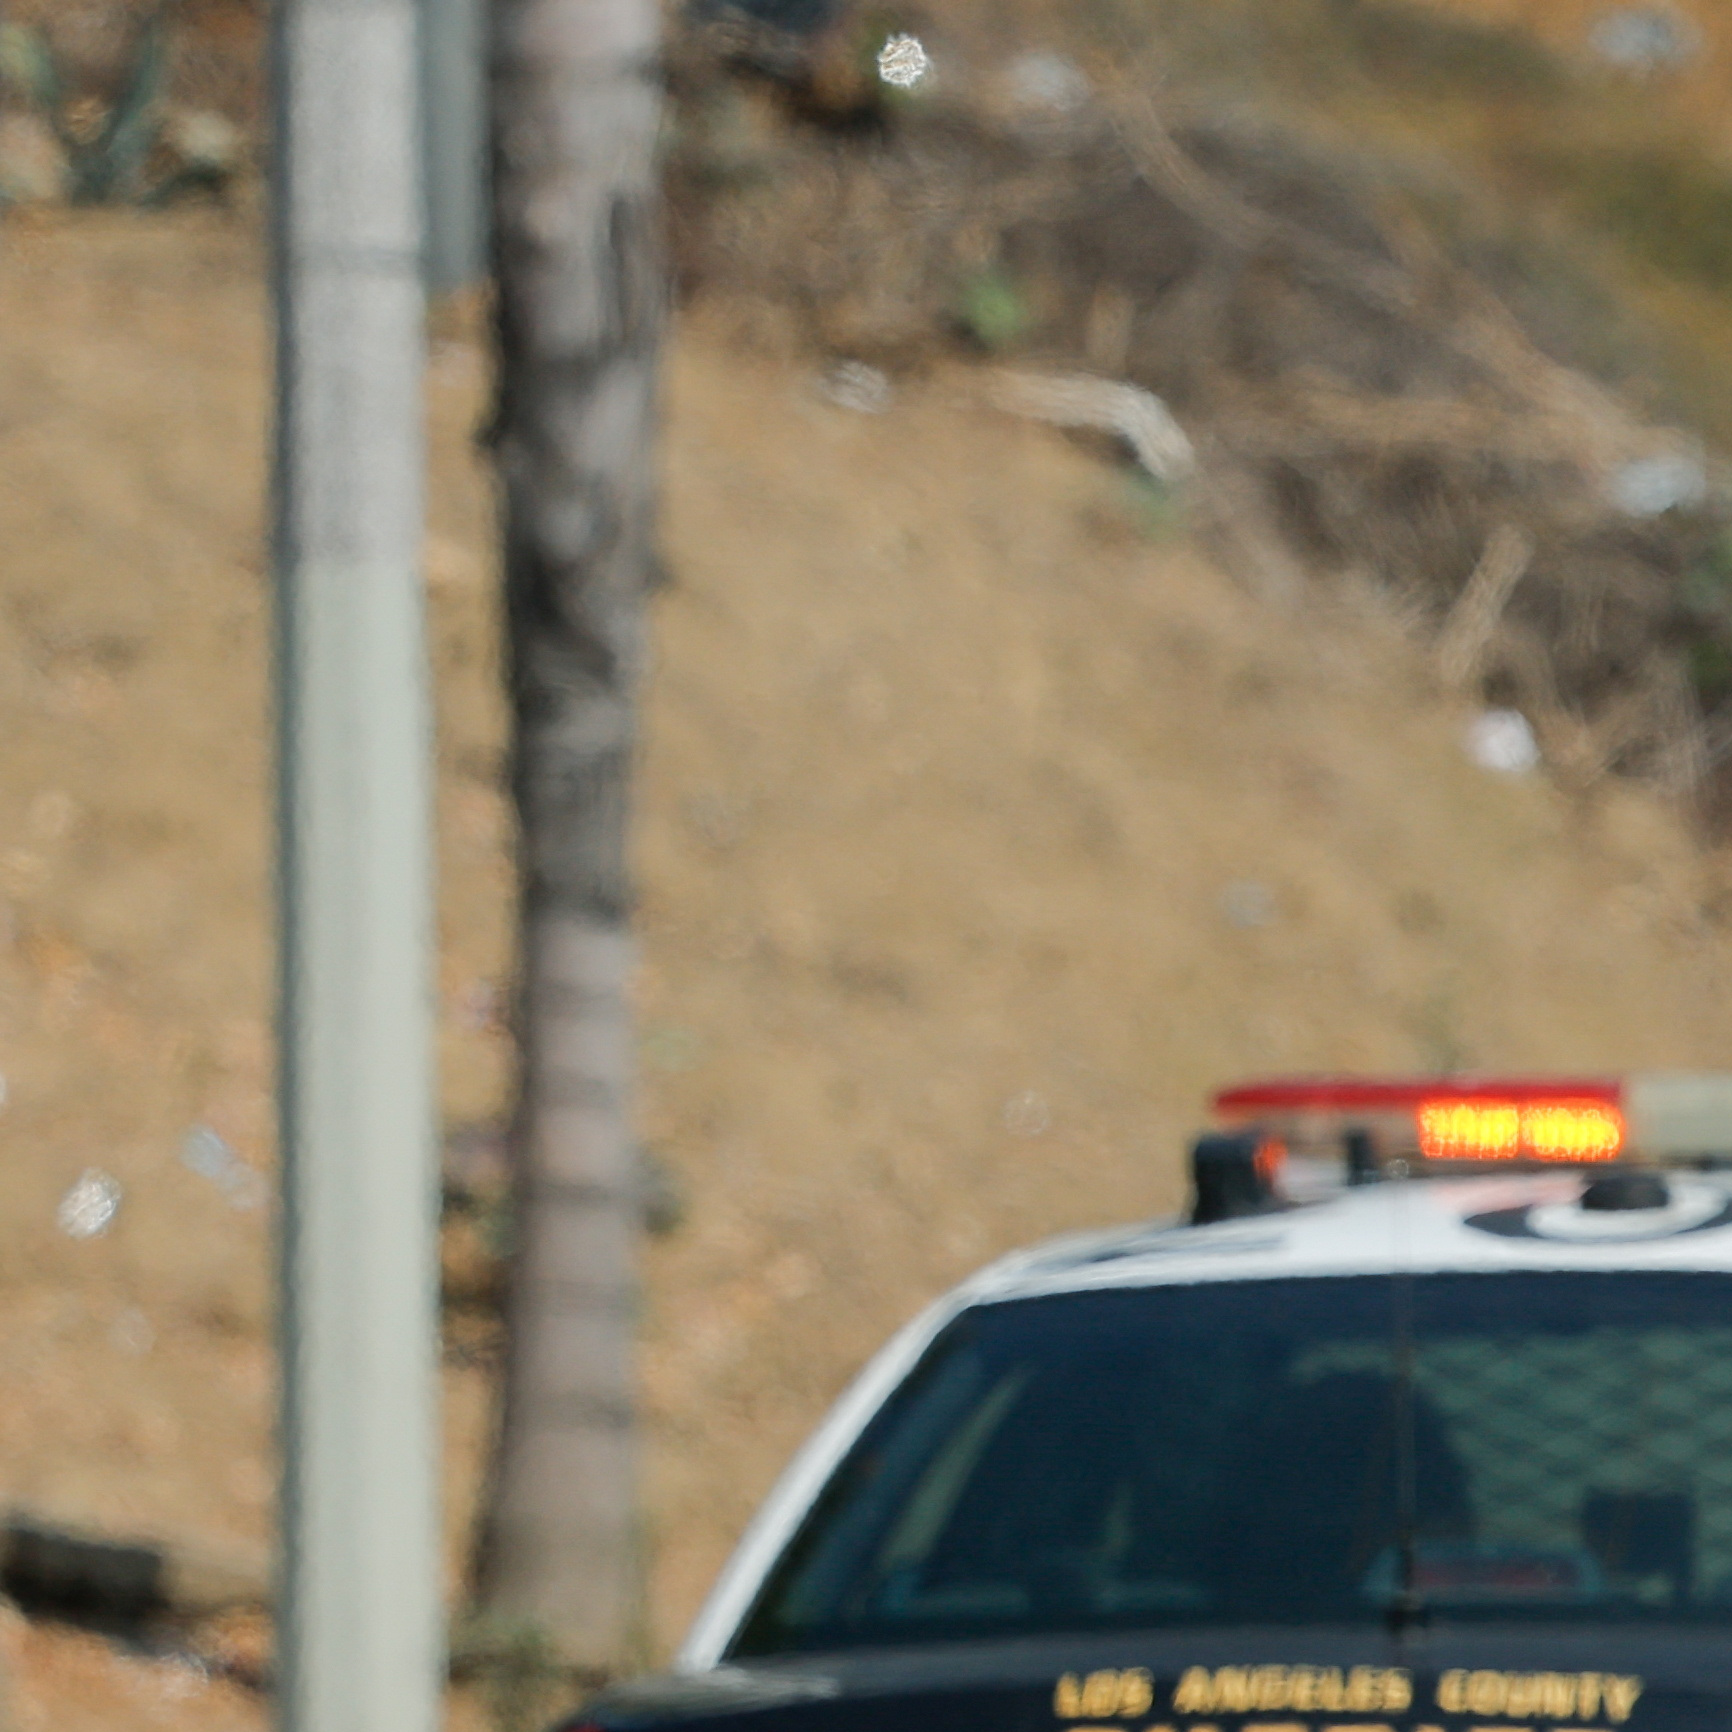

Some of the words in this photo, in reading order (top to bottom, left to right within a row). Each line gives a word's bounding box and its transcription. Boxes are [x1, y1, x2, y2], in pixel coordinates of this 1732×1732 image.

[1053, 1668, 1154, 1719] LOS
[1172, 1664, 1414, 1715] ANGELES
[1436, 1668, 1645, 1724] COUNTY
